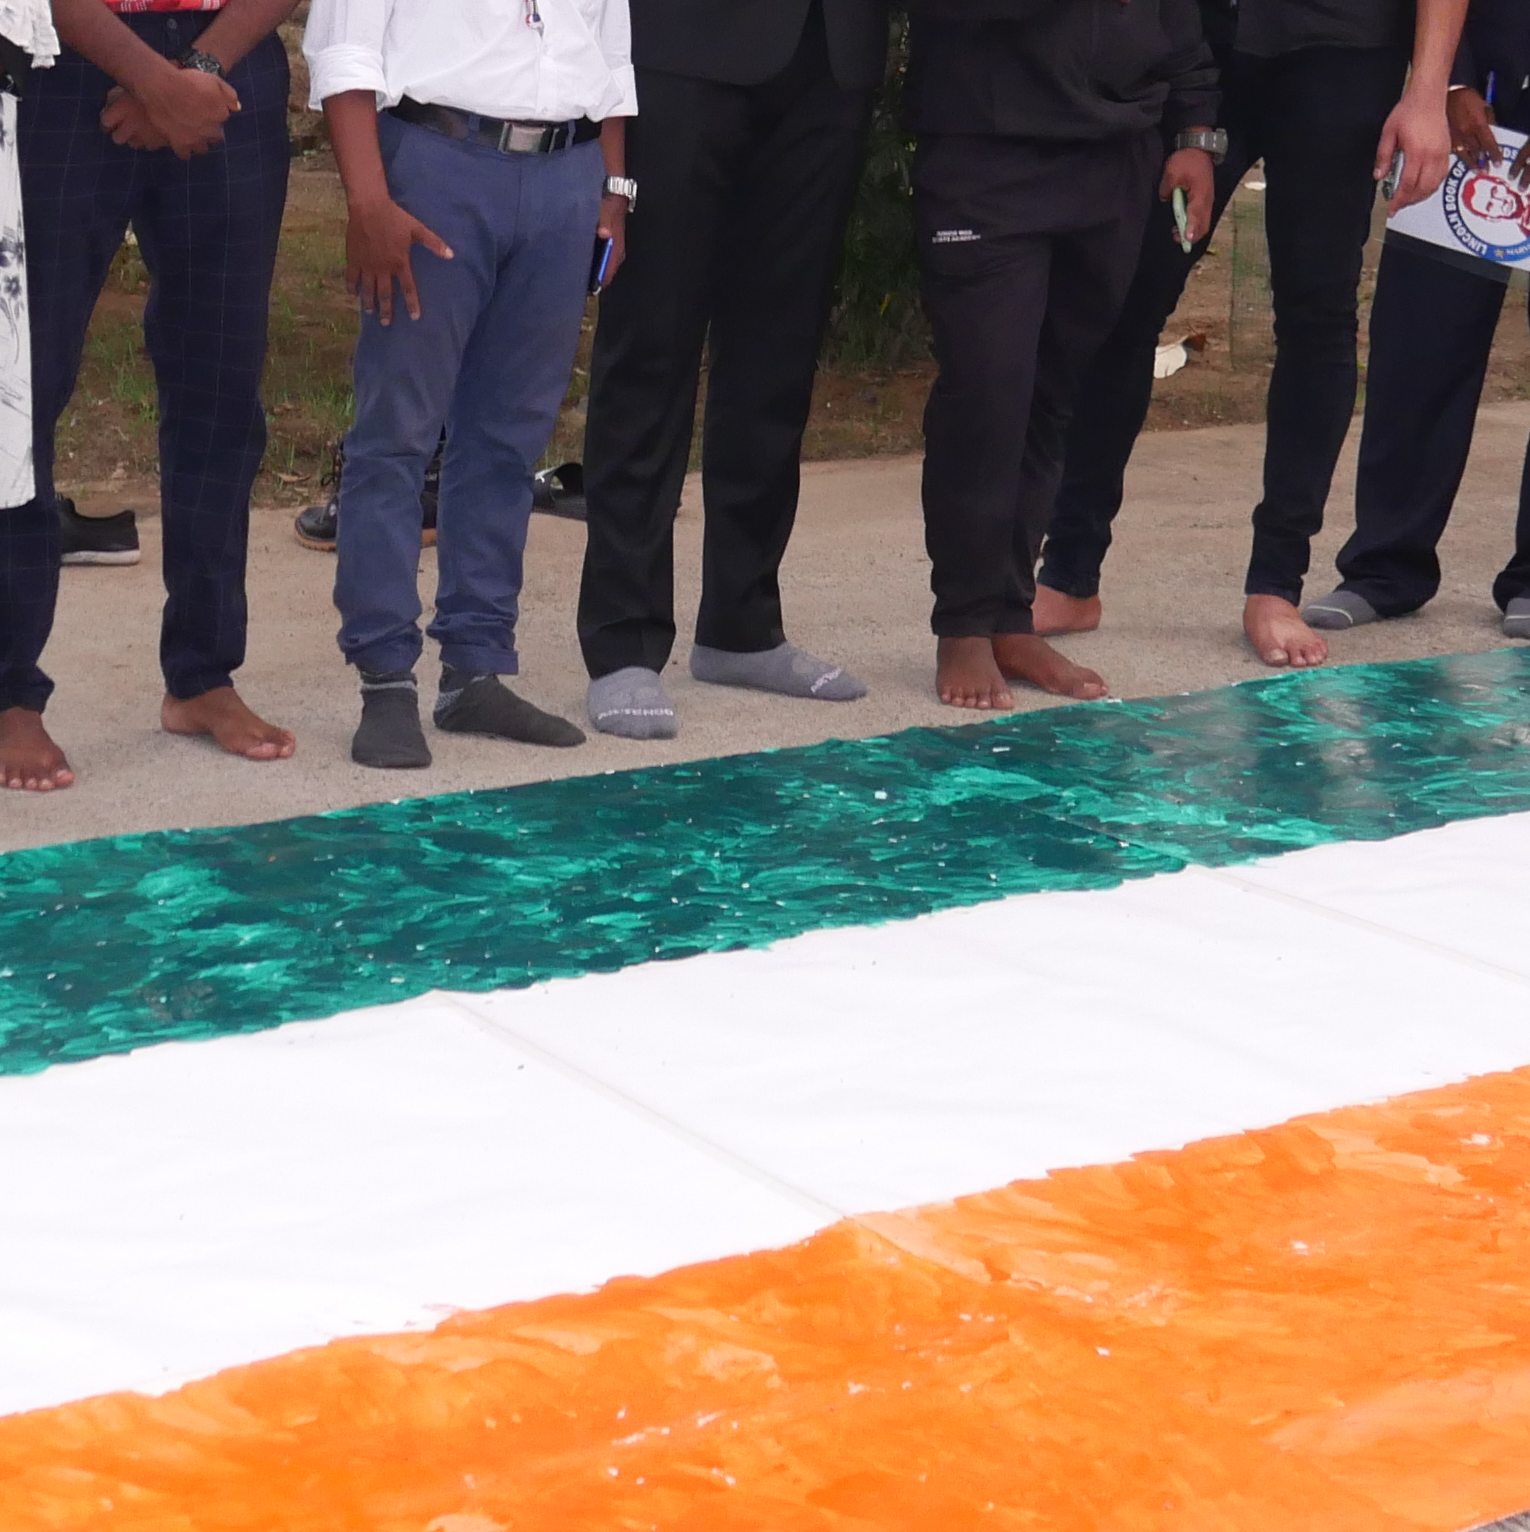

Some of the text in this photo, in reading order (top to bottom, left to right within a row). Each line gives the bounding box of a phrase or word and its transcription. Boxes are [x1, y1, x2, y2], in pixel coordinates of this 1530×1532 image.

[1445, 161, 1488, 255] LINCOLN BOOK OF
